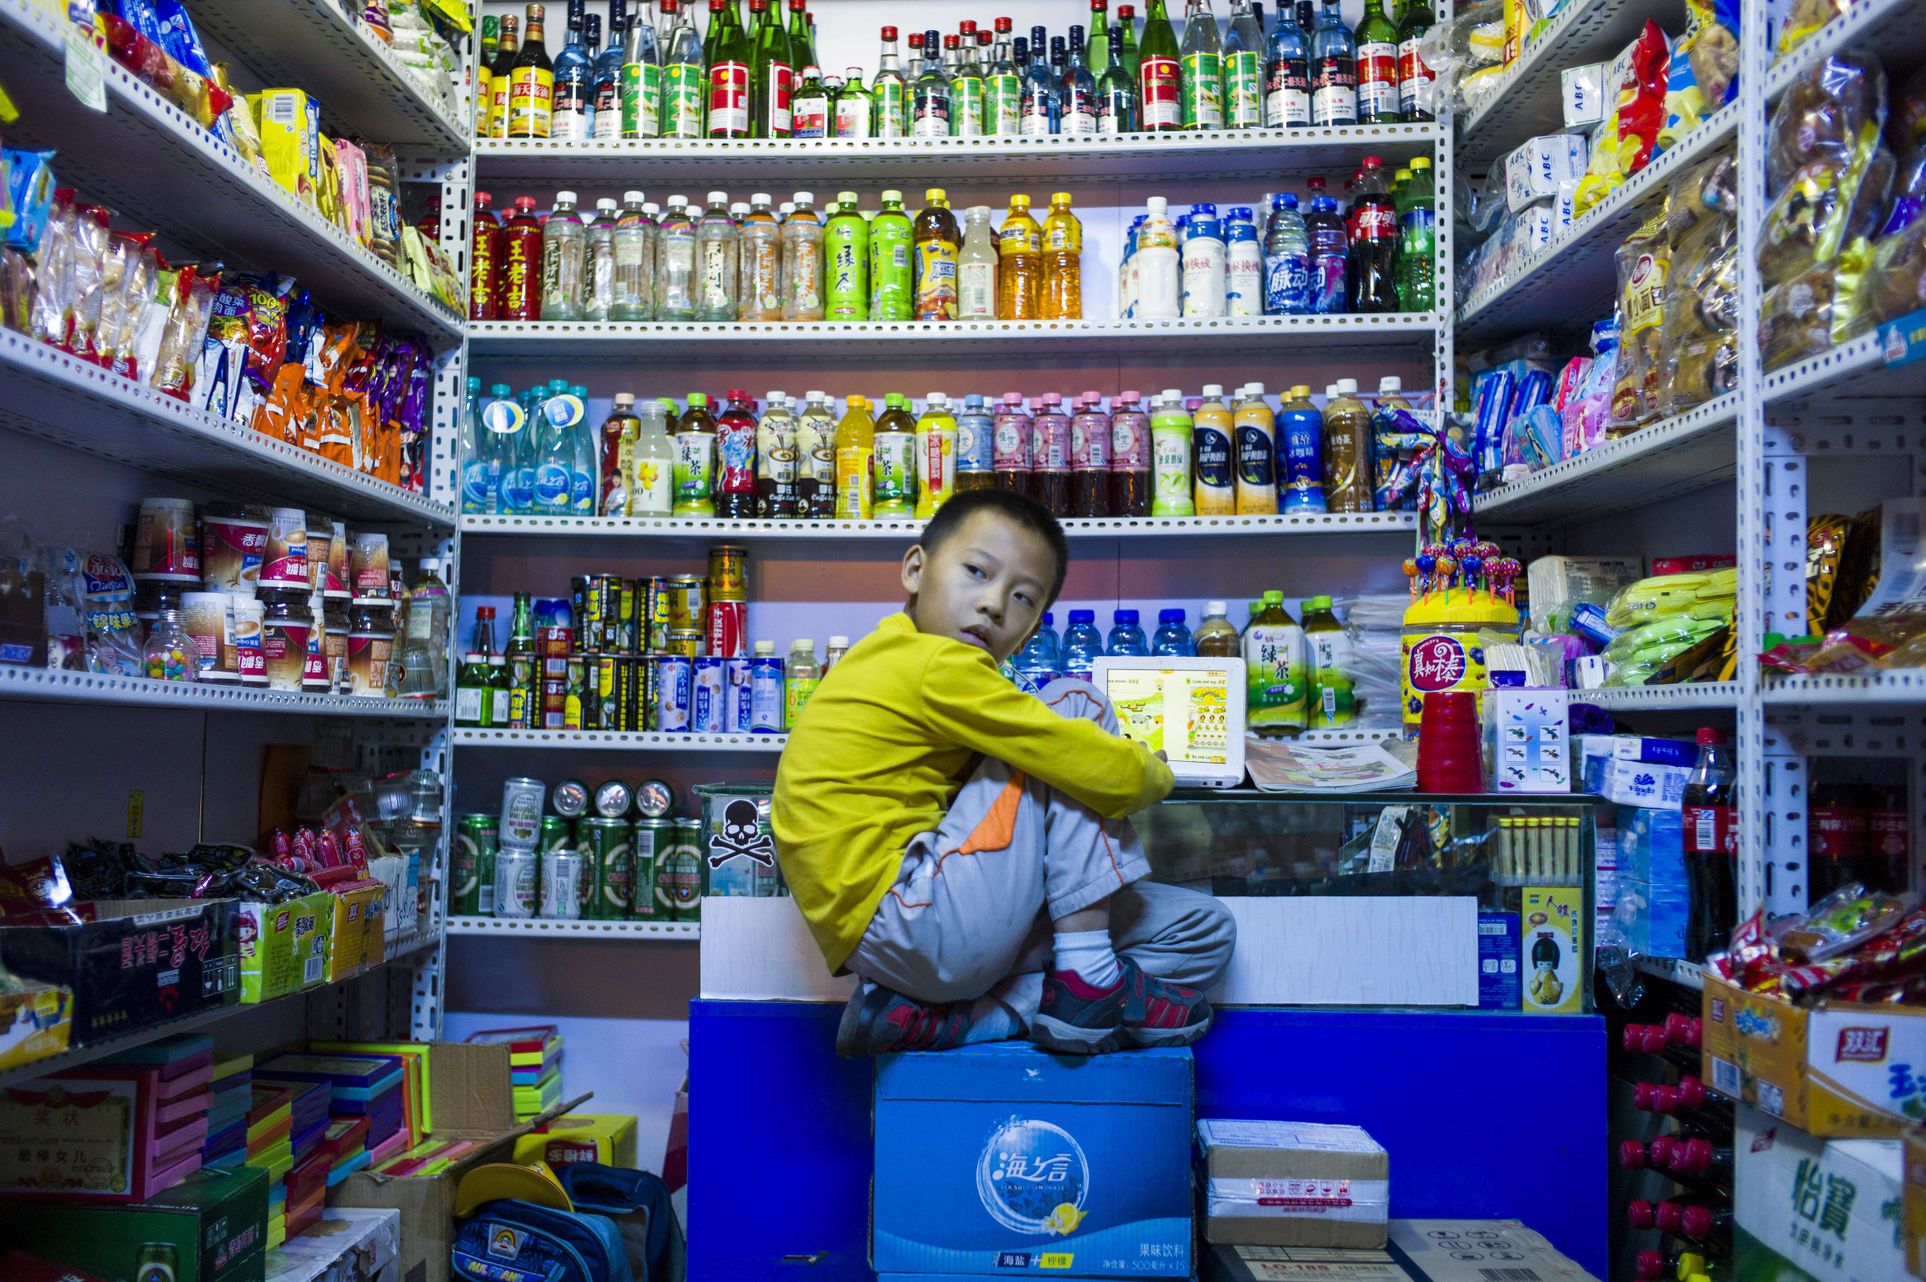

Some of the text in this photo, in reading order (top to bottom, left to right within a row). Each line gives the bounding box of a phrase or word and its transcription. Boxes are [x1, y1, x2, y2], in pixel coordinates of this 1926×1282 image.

[1575, 82, 1583, 110] ABC
[1510, 149, 1525, 166] ABC
[1541, 152, 1552, 180] ABC
[1562, 199, 1571, 226] ABC
[1540, 217, 1549, 243] ABC
[471, 235, 491, 304] 王老吉
[506, 239, 526, 309] 王老吉
[1270, 267, 1308, 293] 脉动
[237, 655, 265, 669] 香飘
[1261, 644, 1289, 679] 绿茶
[1413, 642, 1459, 683] 真知棒
[677, 668, 688, 704] 六个核桃
[1629, 784, 1655, 794] vinda
[1845, 1030, 1883, 1052] 双汇
[33, 1107, 80, 1126] 奖状
[18, 1149, 87, 1164] 最棒女儿
[993, 1152, 1072, 1182] 海之言
[1003, 1254, 1026, 1266] 海盐
[1047, 1255, 1067, 1266] 柠檬
[1140, 1243, 1184, 1258] 果味饮料
